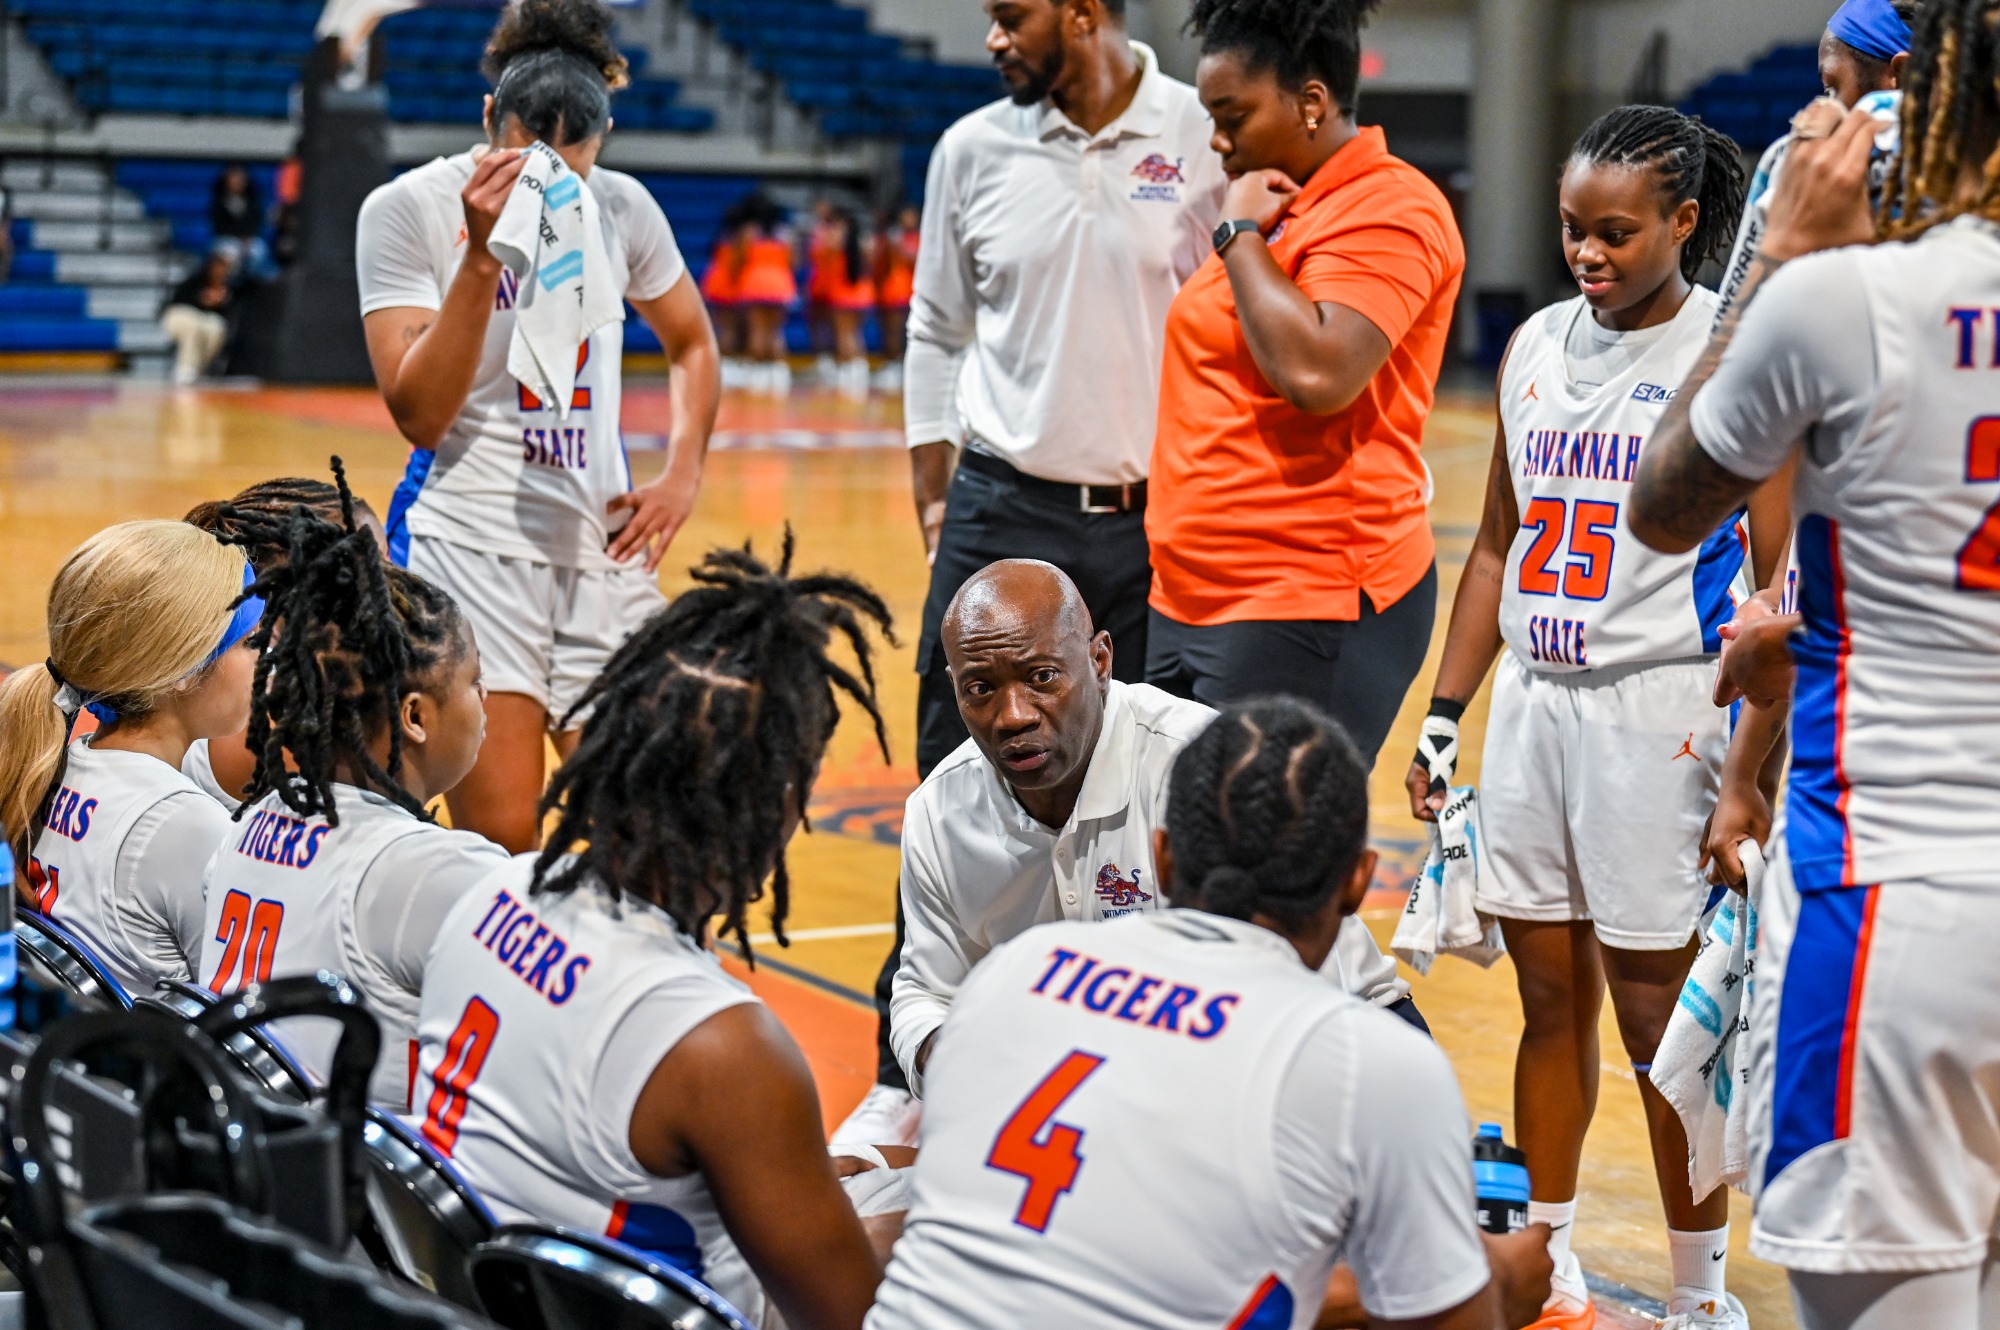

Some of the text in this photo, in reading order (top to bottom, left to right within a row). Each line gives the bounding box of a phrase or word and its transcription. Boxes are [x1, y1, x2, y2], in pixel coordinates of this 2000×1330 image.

[523, 428, 587, 469] STATE
[1523, 430, 1643, 482] SAVANNAH
[1518, 496, 1619, 601] 25
[1529, 614, 1587, 666] STATE
[237, 809, 332, 869] TIGERS
[471, 889, 592, 1007] TIGERS
[1030, 946, 1242, 1041] TIGERS
[420, 994, 501, 1160] 0
[984, 1048, 1107, 1235] 4
